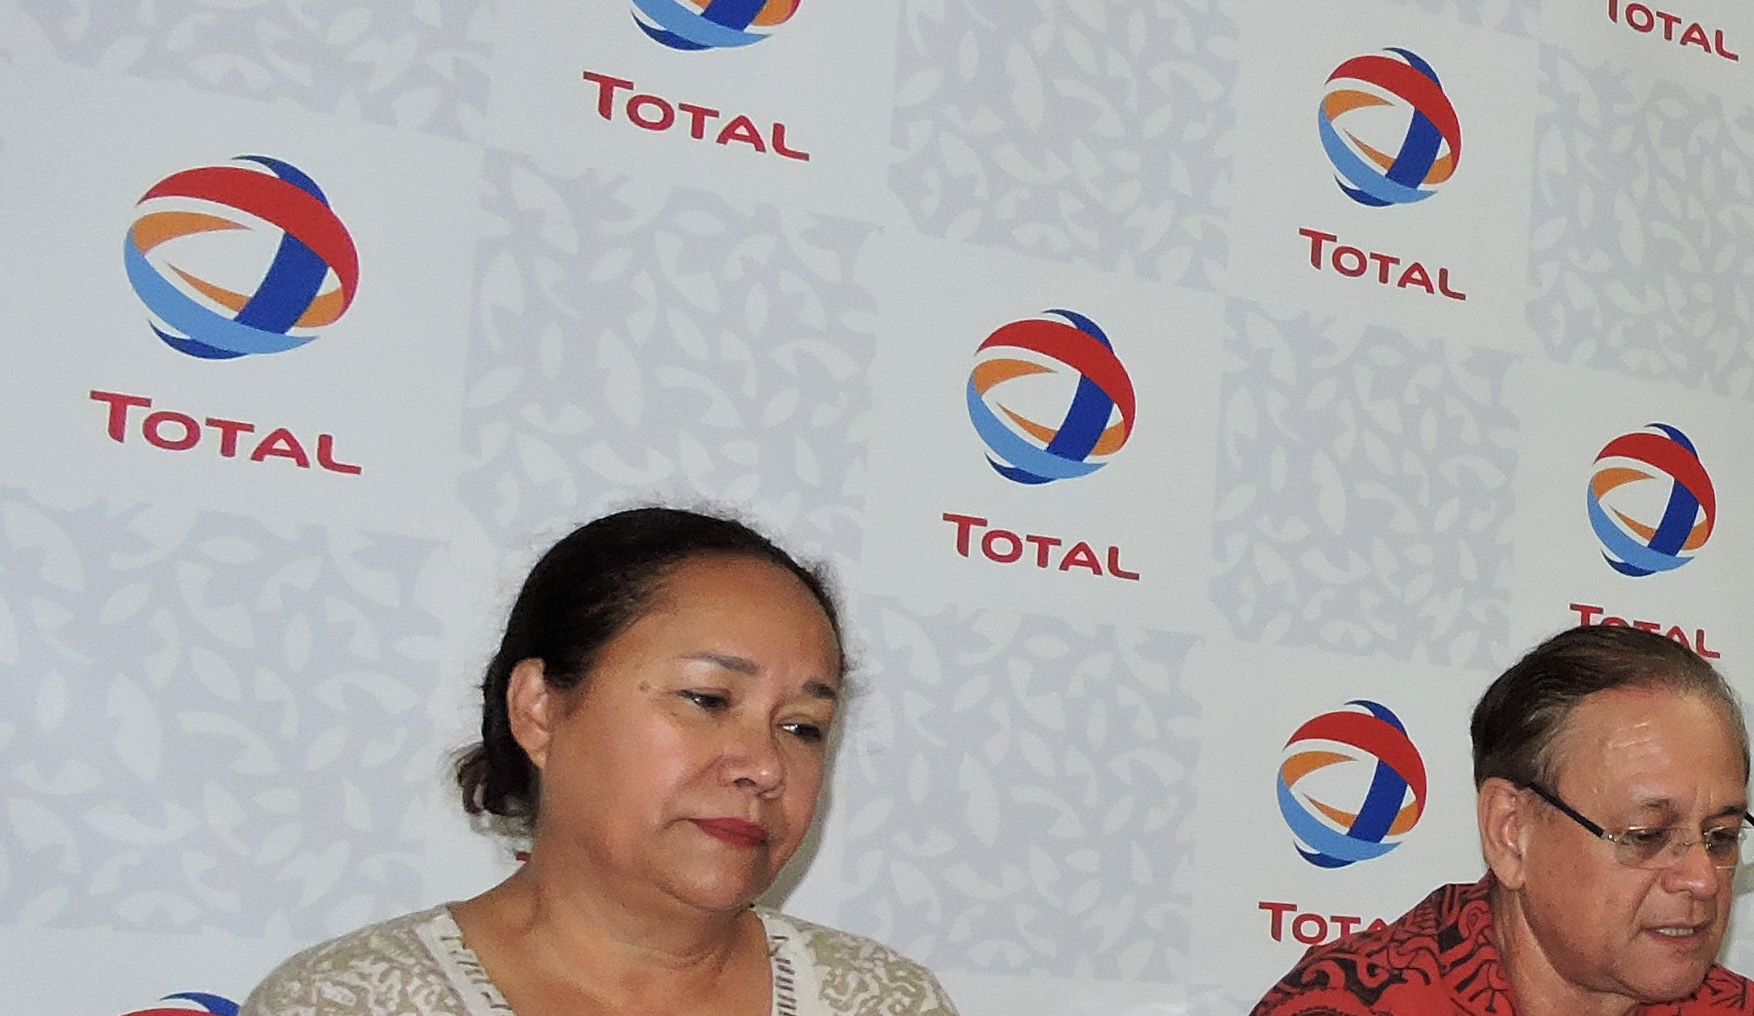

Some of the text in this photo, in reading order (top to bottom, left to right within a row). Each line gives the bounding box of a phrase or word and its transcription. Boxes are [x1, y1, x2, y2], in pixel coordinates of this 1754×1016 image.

[583, 71, 810, 161] TOTAL
[1299, 228, 1466, 301] TOTAL
[90, 390, 362, 475] TOTAL
[942, 513, 1140, 580] TOTAL
[1258, 901, 1388, 944] TOT
